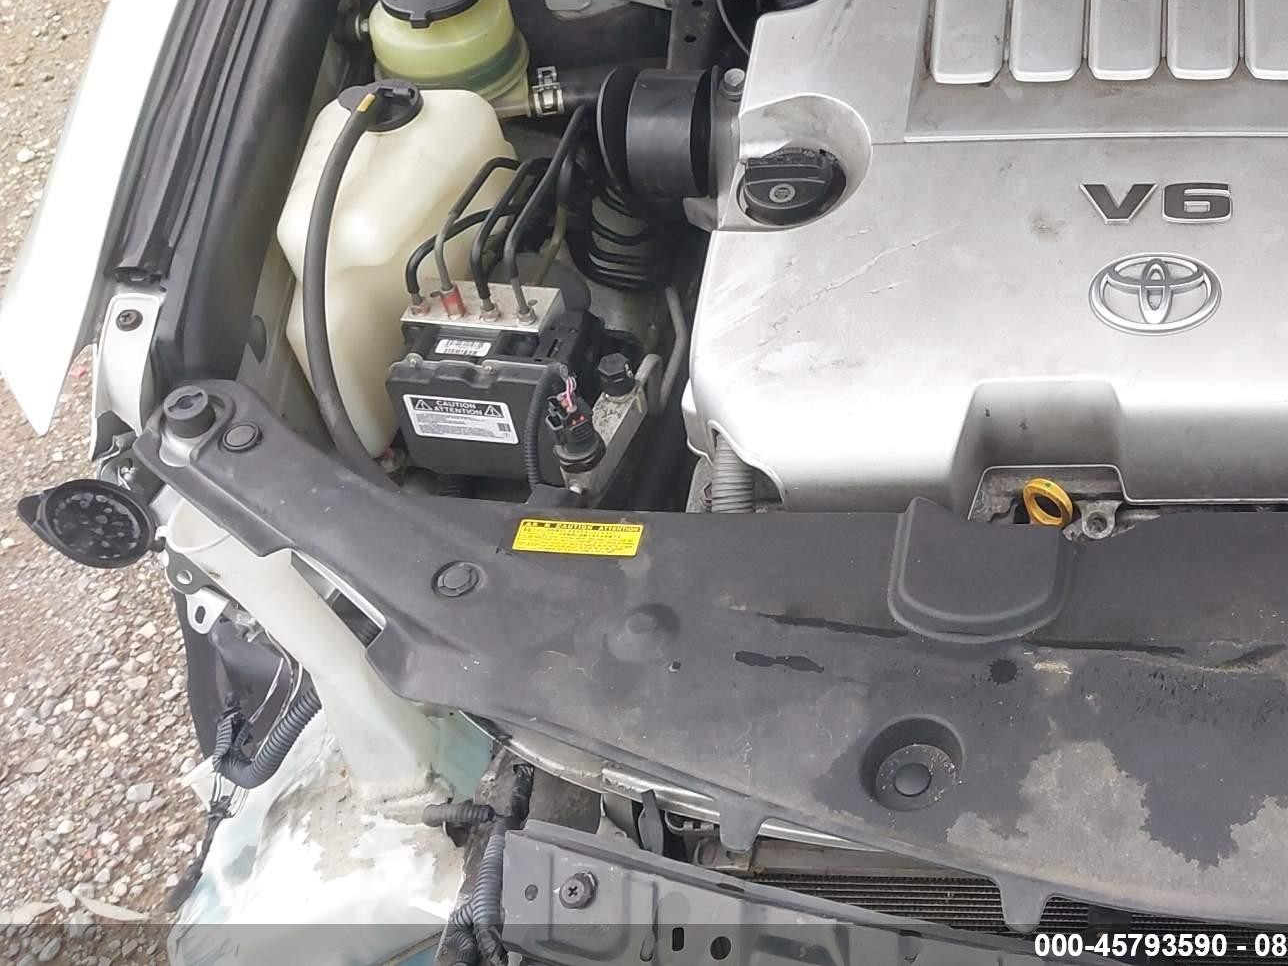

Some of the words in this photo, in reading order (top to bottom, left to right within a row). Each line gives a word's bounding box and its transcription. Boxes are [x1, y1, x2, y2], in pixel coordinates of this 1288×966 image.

[1079, 182, 1233, 224] V6
[435, 400, 477, 409] CAUTION
[434, 405, 483, 416] ATTENTION
[555, 523, 593, 531] CAUTION
